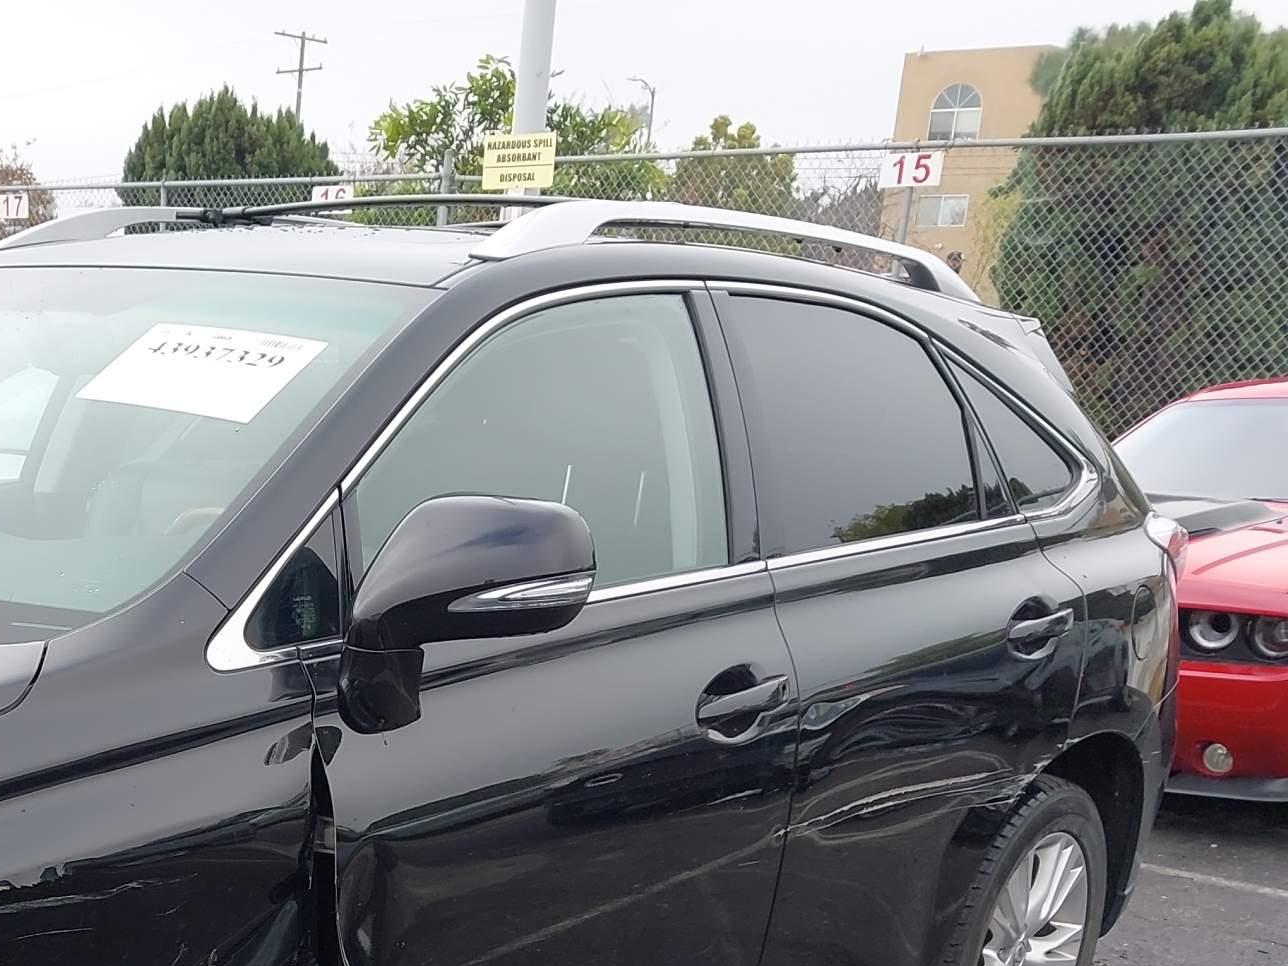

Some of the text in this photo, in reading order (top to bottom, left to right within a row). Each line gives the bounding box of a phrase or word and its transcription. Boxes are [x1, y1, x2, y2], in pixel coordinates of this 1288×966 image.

[487, 138, 552, 150] HAZARDOUS SPILL
[496, 152, 541, 163] ABSORBANT
[499, 172, 535, 183] DISPOSAL
[893, 154, 931, 184] 15
[2, 195, 23, 217] 17
[148, 341, 285, 367] 43937329
